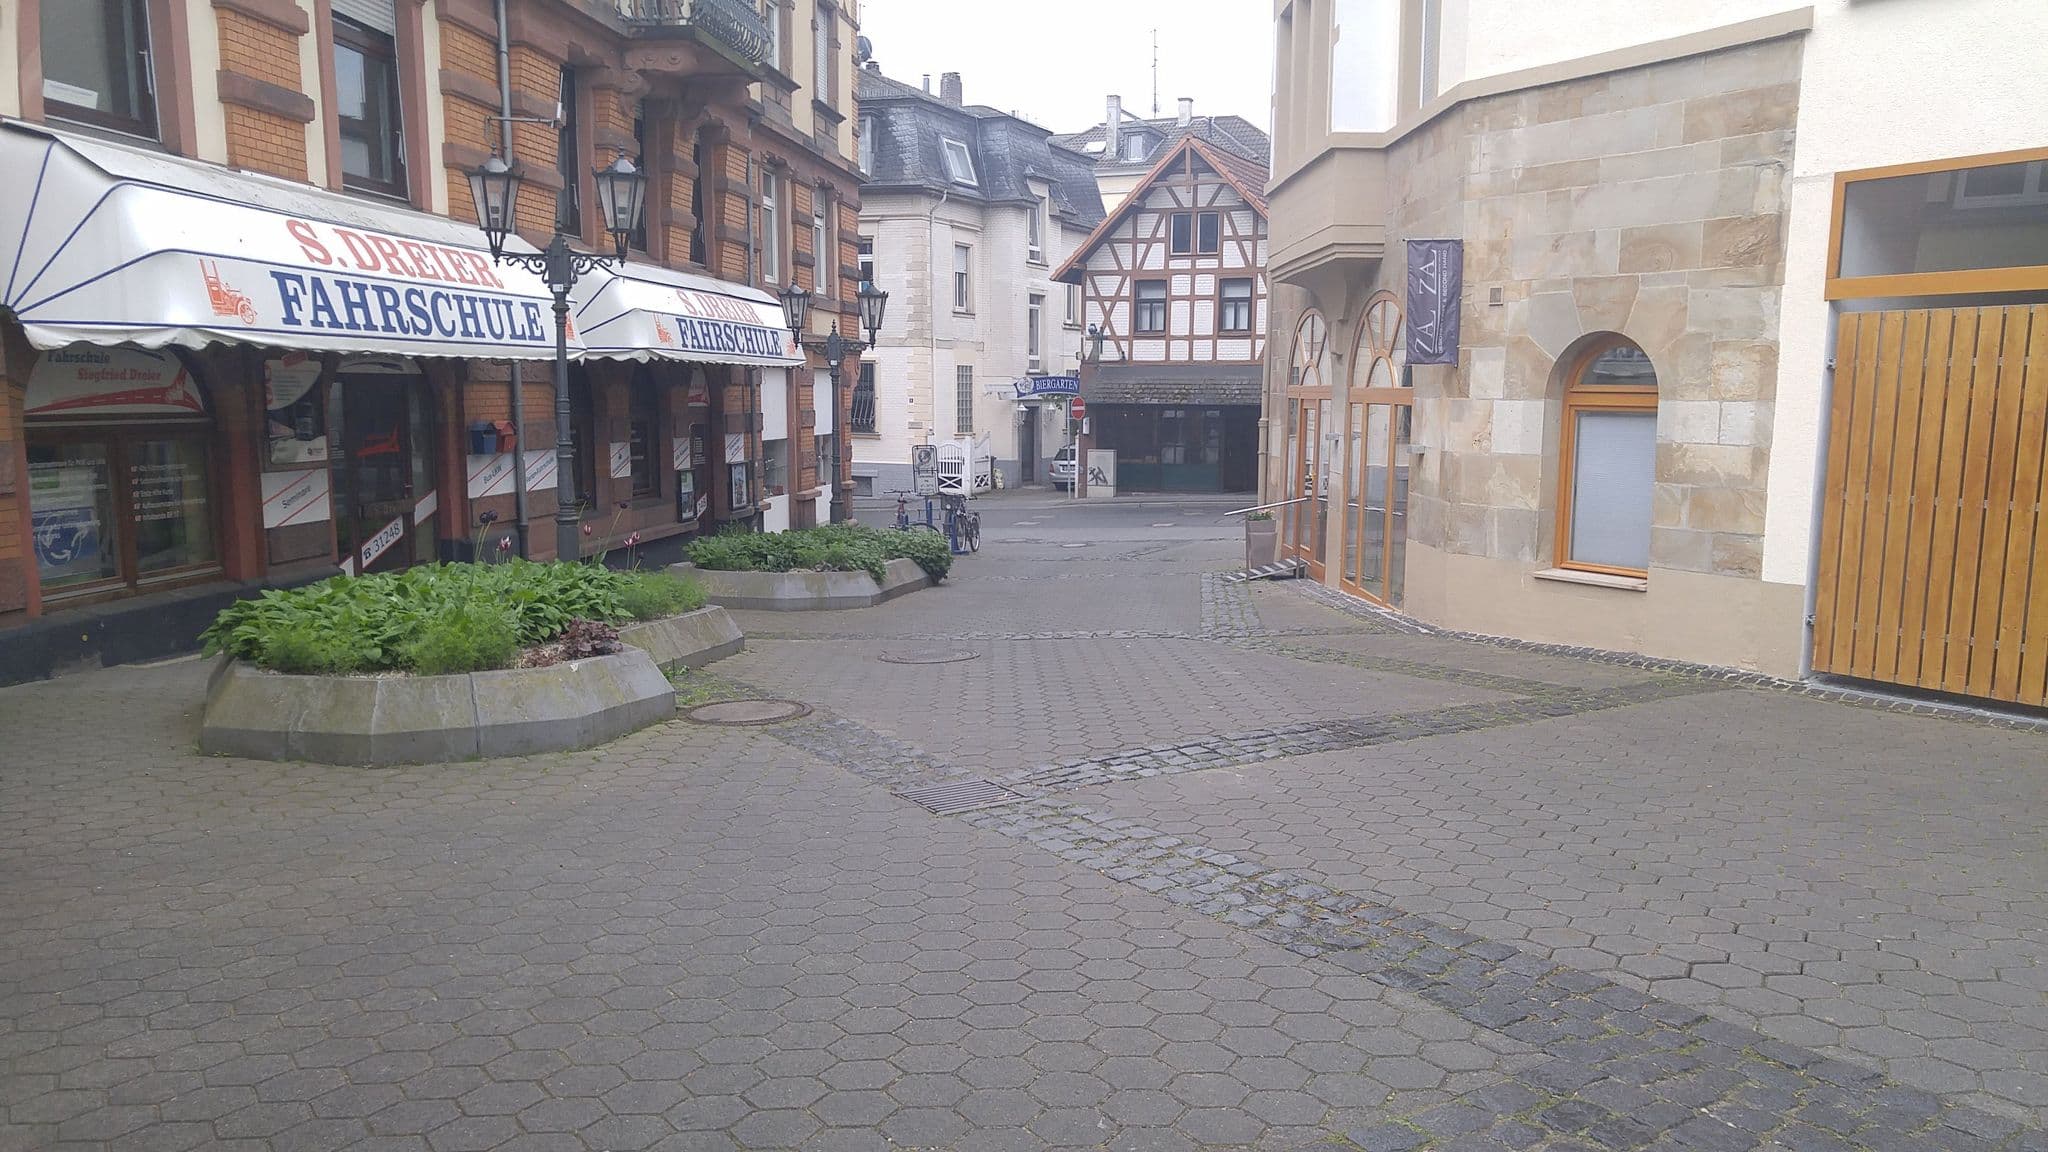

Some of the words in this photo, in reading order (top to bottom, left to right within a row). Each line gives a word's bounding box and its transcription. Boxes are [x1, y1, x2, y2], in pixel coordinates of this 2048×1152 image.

[286, 219, 504, 289] S.DREIER
[269, 270, 546, 342] FAHRSCHULE
[675, 317, 783, 357] FAHRSCHULE
[1035, 378, 1079, 391] BIERGARTEN
[373, 522, 401, 553] 31248
